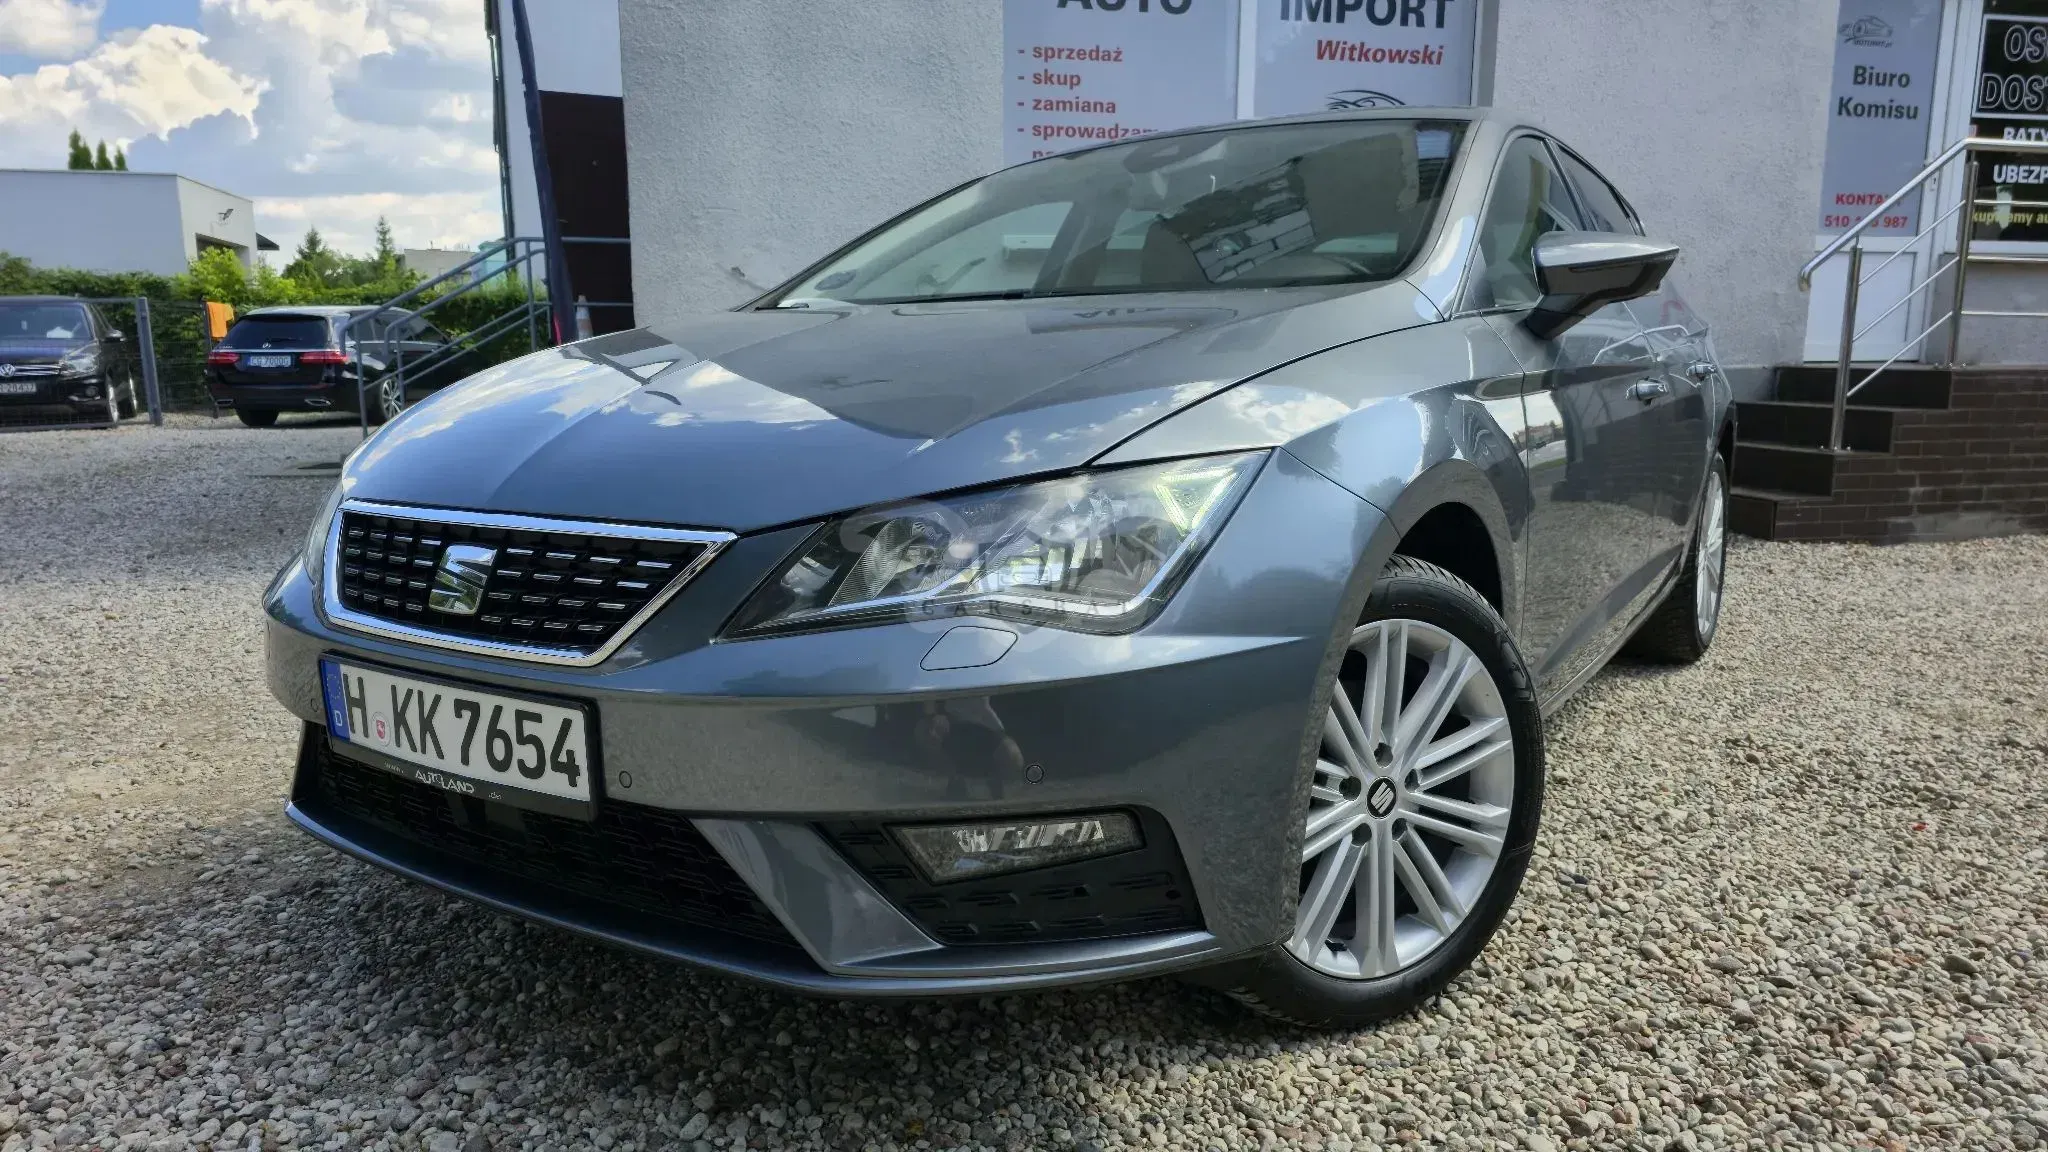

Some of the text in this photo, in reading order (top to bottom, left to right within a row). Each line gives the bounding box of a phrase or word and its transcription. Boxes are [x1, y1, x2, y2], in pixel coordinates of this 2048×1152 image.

[1279, 0, 1452, 29] IMPORT
[1032, 45, 1123, 63] sprzedaż
[1316, 40, 1445, 66] Witkowski
[2004, 25, 2048, 63] OS
[1032, 68, 1082, 90] skup
[1853, 65, 1911, 89] Biuro
[1980, 73, 2048, 111] DOS
[1032, 96, 1116, 114] zamiana
[1838, 96, 1919, 120] Komisu
[1824, 215, 1850, 228] 510
[1883, 216, 1908, 229] 987
[343, 674, 369, 739] H
[391, 685, 444, 760] KK
[453, 698, 581, 788] 7654
